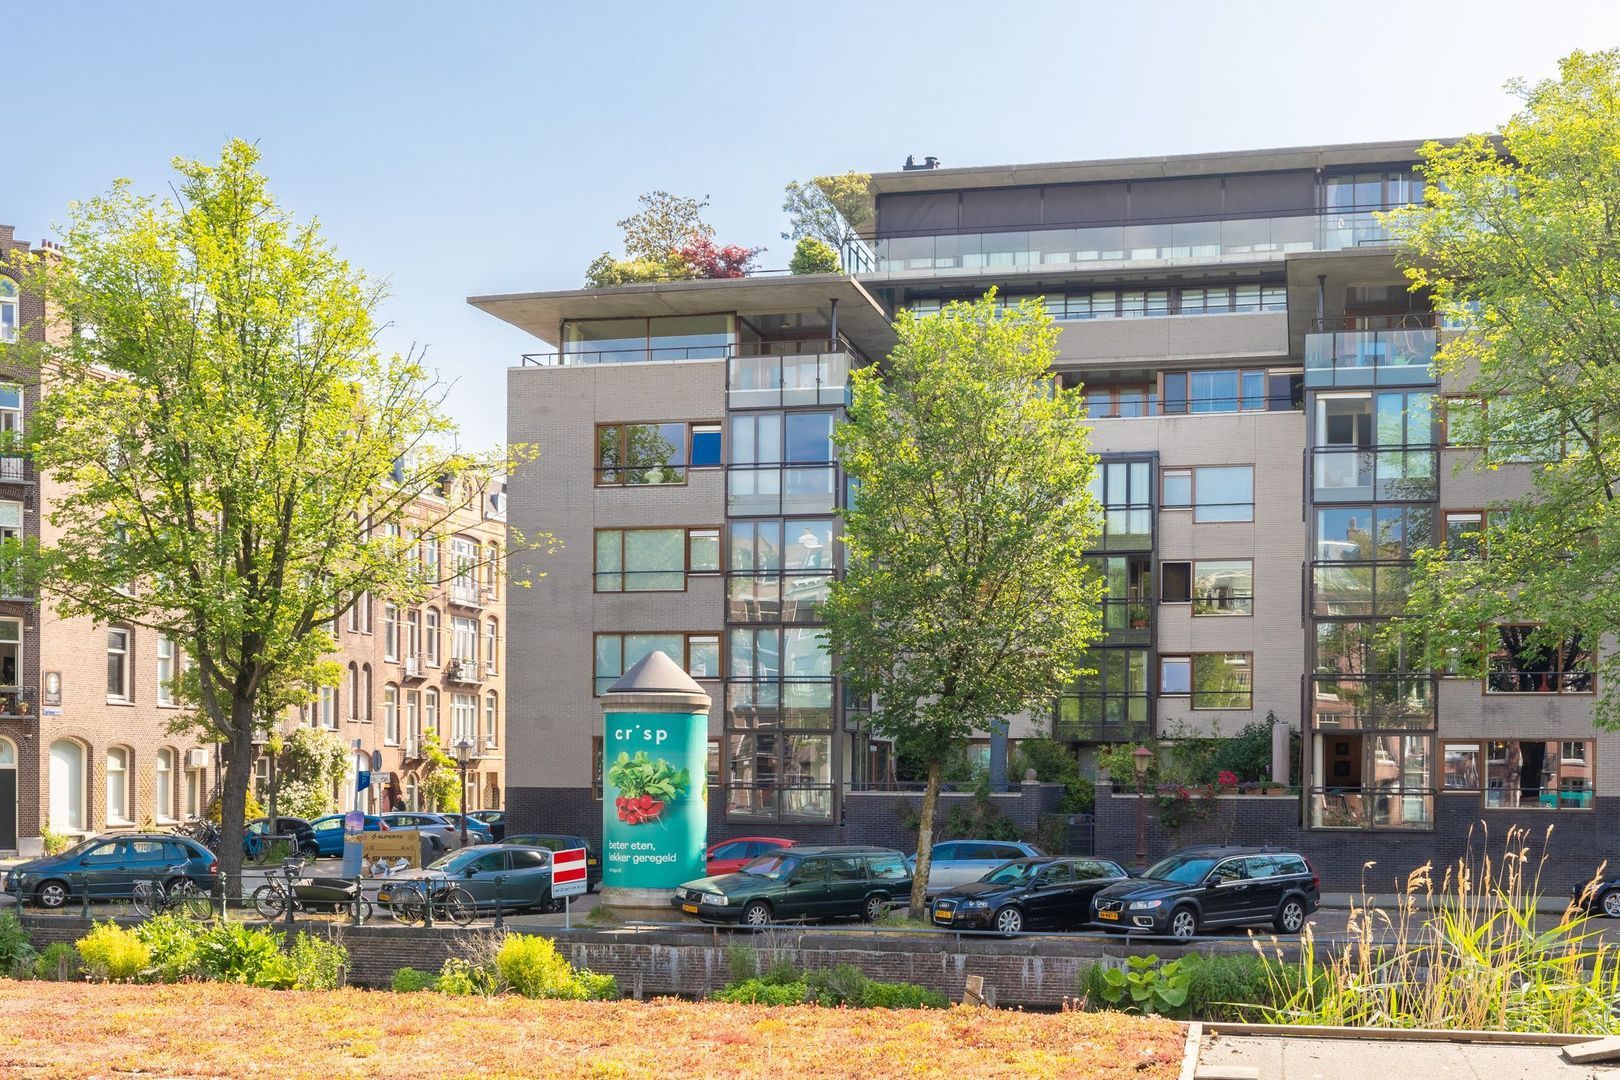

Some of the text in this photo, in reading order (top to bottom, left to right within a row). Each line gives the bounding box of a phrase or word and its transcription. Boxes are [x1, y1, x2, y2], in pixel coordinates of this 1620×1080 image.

[608, 840, 656, 851] beter eten,
[608, 852, 631, 863] lekker
[632, 853, 677, 865] geregeld
